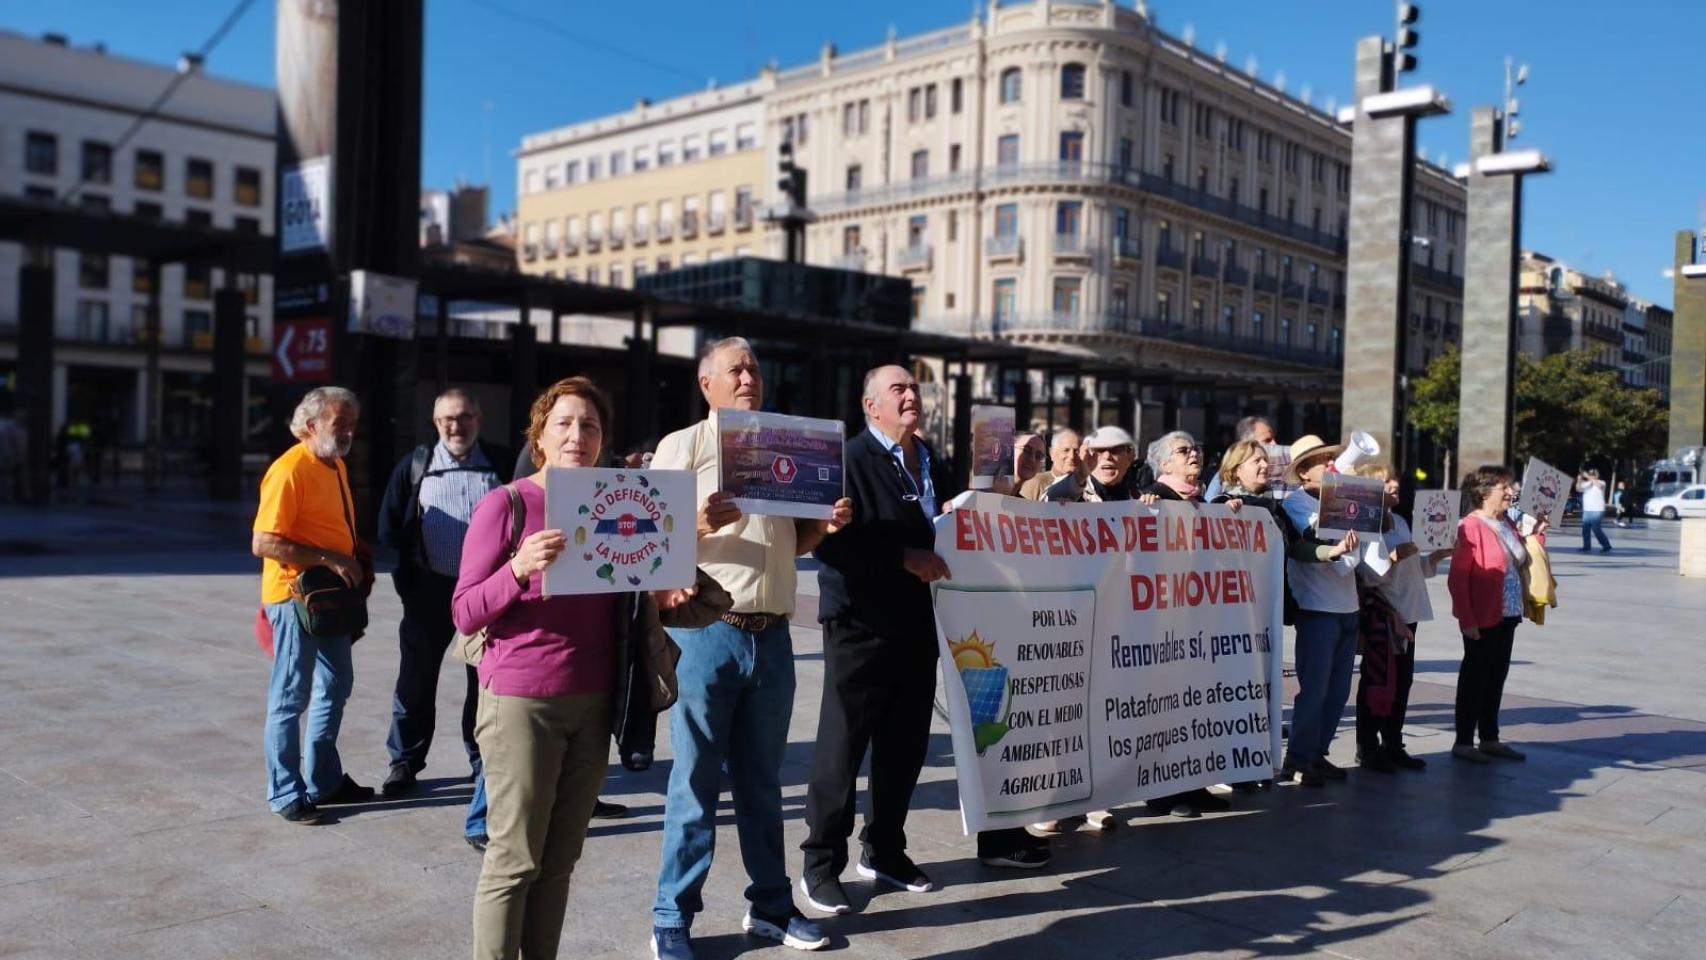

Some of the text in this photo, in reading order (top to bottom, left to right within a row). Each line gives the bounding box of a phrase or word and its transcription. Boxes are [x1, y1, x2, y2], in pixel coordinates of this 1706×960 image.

[590, 488, 661, 521] YO DEFIENDO
[617, 521, 637, 529] STOP
[956, 508, 1267, 555] EN DEFENSA DE LA HUERTA
[595, 541, 658, 565] LA HUERTA
[1131, 573, 1168, 611] DE
[1033, 609, 1077, 628] POR LAS
[1017, 640, 1084, 662] RENOVABLES
[1111, 629, 1185, 669] Renovables
[1189, 631, 1206, 660] sí,
[1211, 633, 1251, 663] pero
[1011, 671, 1085, 696] RESPETUOSAS
[1008, 702, 1083, 730] CON EL MEDIO
[1105, 693, 1179, 721] Plataforma
[1182, 685, 1202, 708] de
[1000, 734, 1084, 763] AMBIENTE Y LA
[1108, 735, 1132, 759] los
[1135, 725, 1189, 760] parques
[1000, 767, 1084, 796] AGRICULTURA
[1137, 765, 1150, 788] la
[1153, 755, 1202, 783] huerta
[1205, 750, 1226, 773] de
